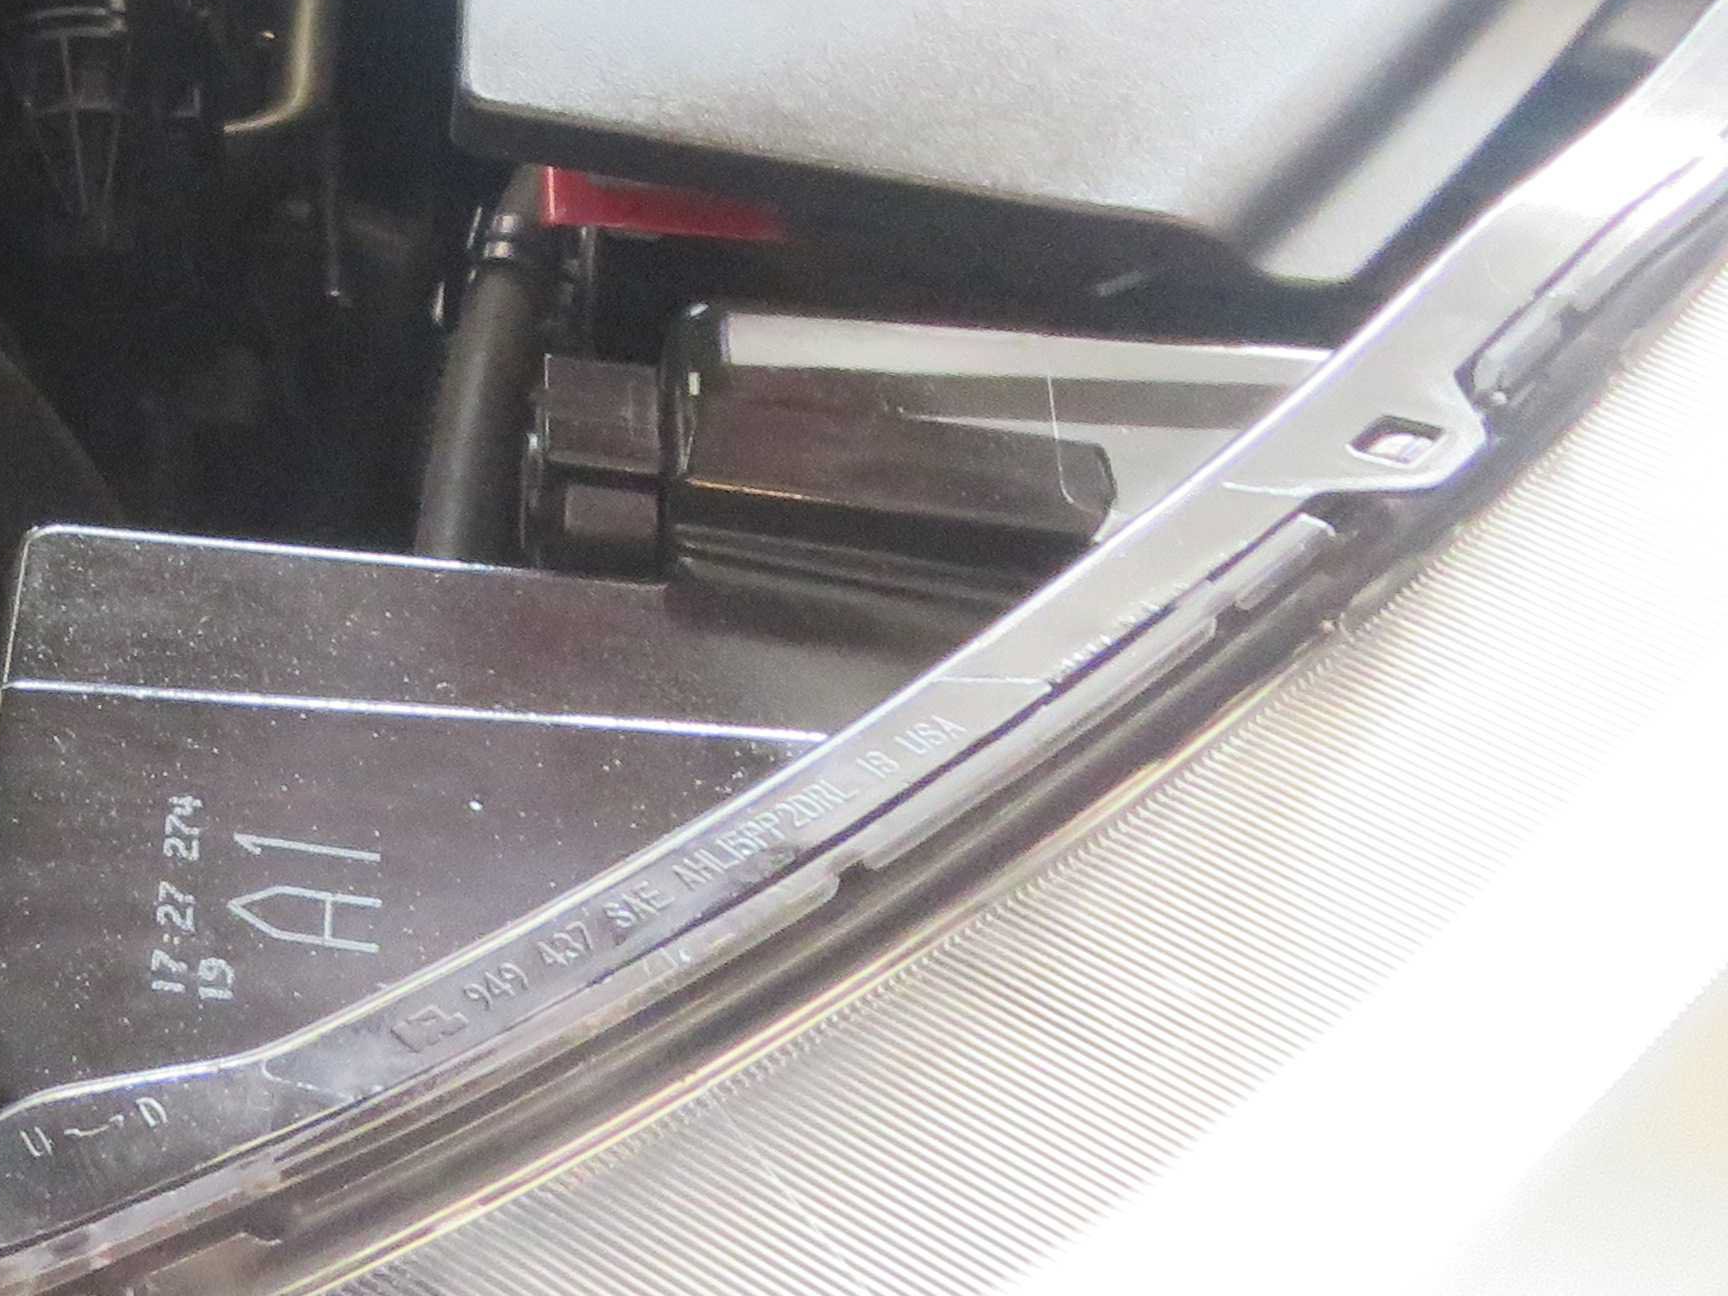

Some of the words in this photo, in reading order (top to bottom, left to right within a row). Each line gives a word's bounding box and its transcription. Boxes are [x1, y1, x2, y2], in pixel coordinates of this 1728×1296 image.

[162, 793, 204, 862] 274
[462, 962, 530, 1011] 949
[604, 880, 676, 930] SAE
[894, 713, 968, 757] USA
[150, 880, 197, 994] 17:27
[227, 831, 383, 954] A1
[198, 956, 235, 1001] 19
